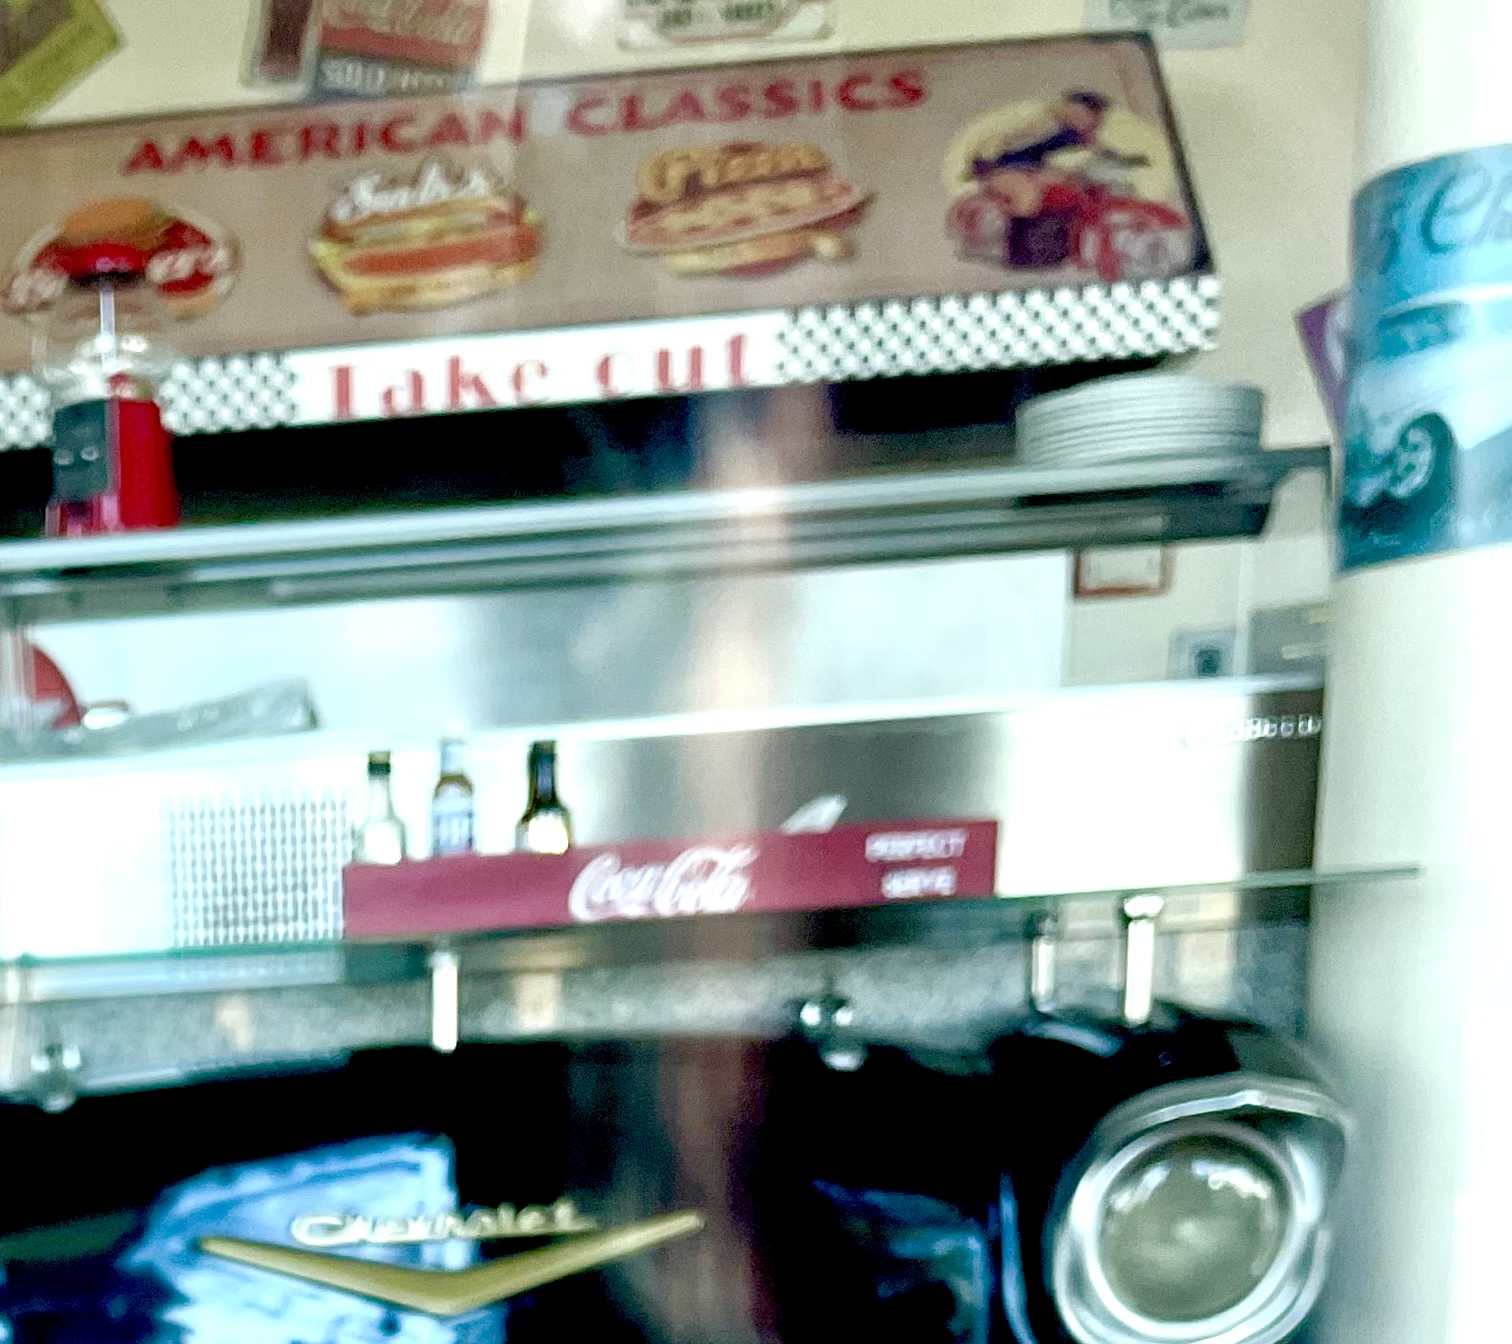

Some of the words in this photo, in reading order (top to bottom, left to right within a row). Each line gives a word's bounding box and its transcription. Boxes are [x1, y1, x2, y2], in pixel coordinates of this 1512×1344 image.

[124, 106, 524, 174] AMERICAN
[566, 70, 930, 136] CLASSICS
[597, 332, 750, 396] out
[292, 1197, 594, 1246] Chevrolet
